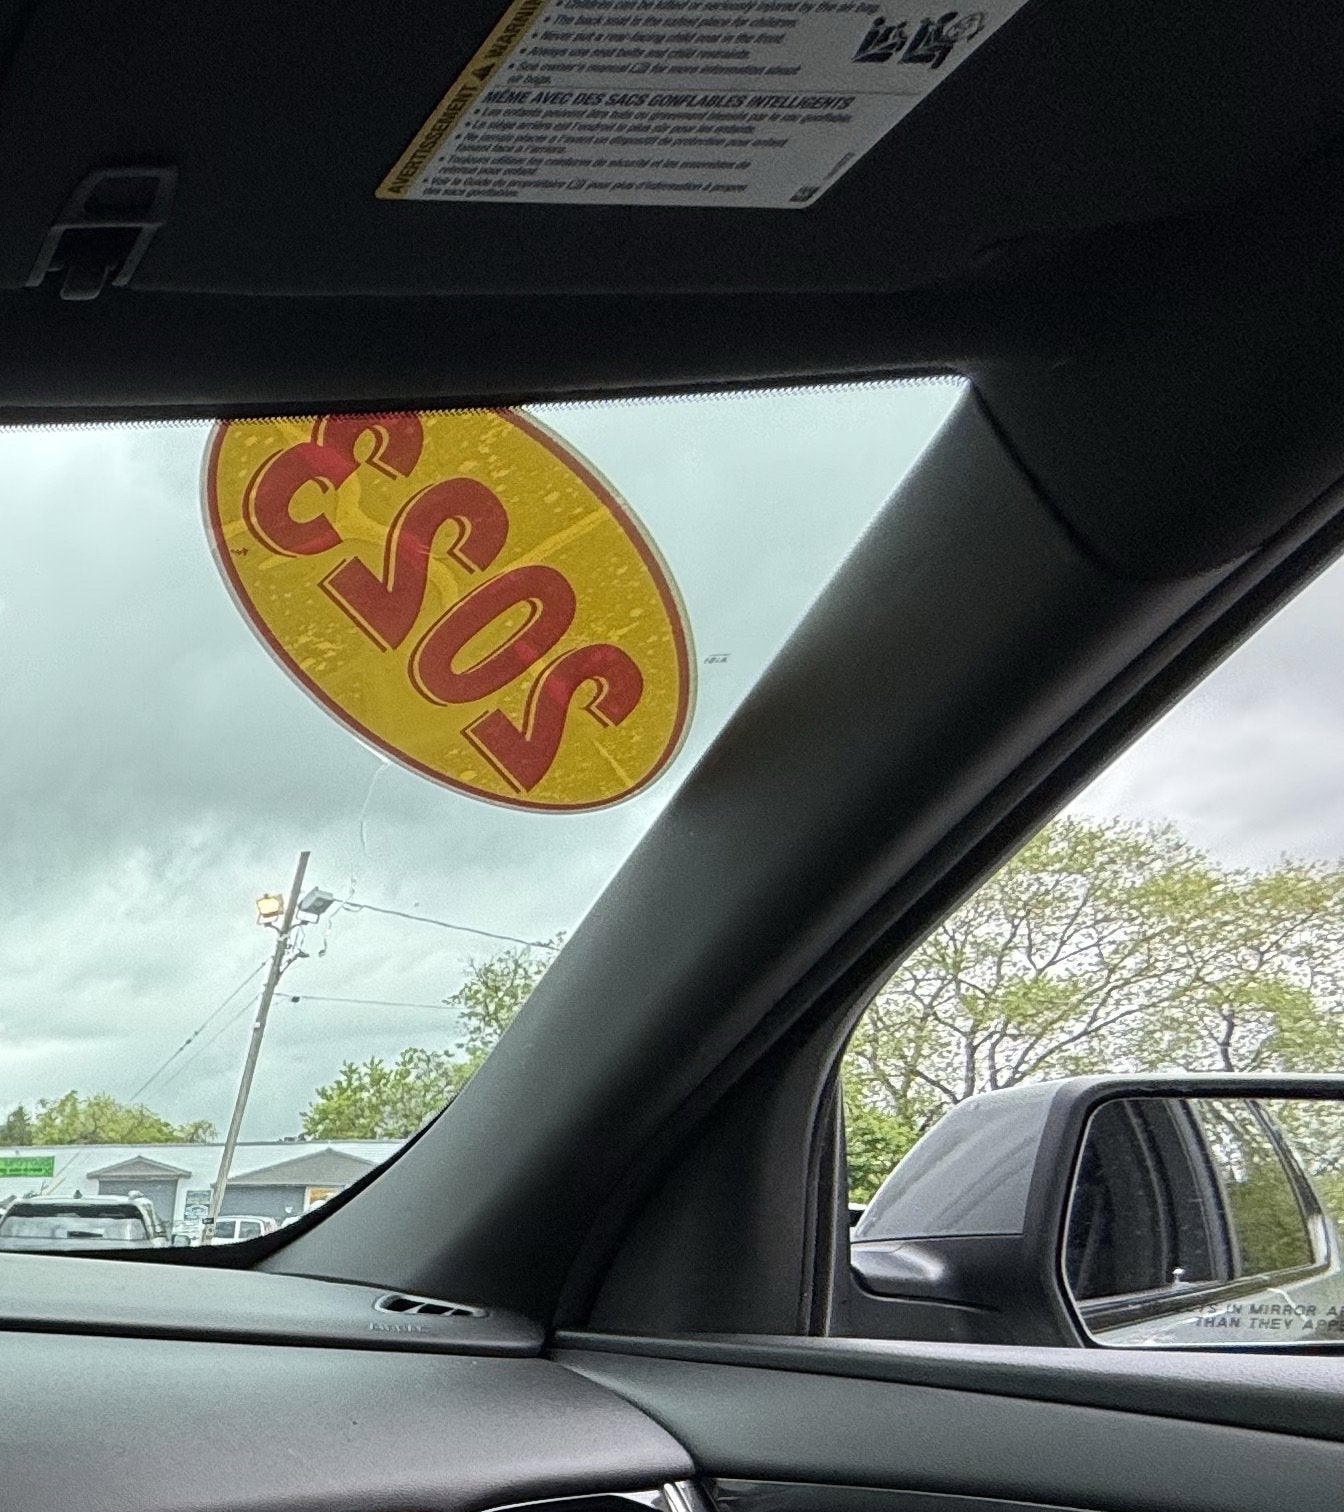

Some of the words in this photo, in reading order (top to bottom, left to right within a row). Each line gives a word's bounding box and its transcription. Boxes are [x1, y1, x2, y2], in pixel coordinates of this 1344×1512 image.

[486, 0, 542, 59] WARNIN
[530, 91, 574, 105] AVEC
[387, 84, 478, 195] AVERTISSEMENT
[1248, 1303, 1316, 1316] MIRROR
[1195, 1316, 1241, 1328] THAN
[1250, 1317, 1294, 1330] THEY
[1302, 1318, 1344, 1331] APPE
